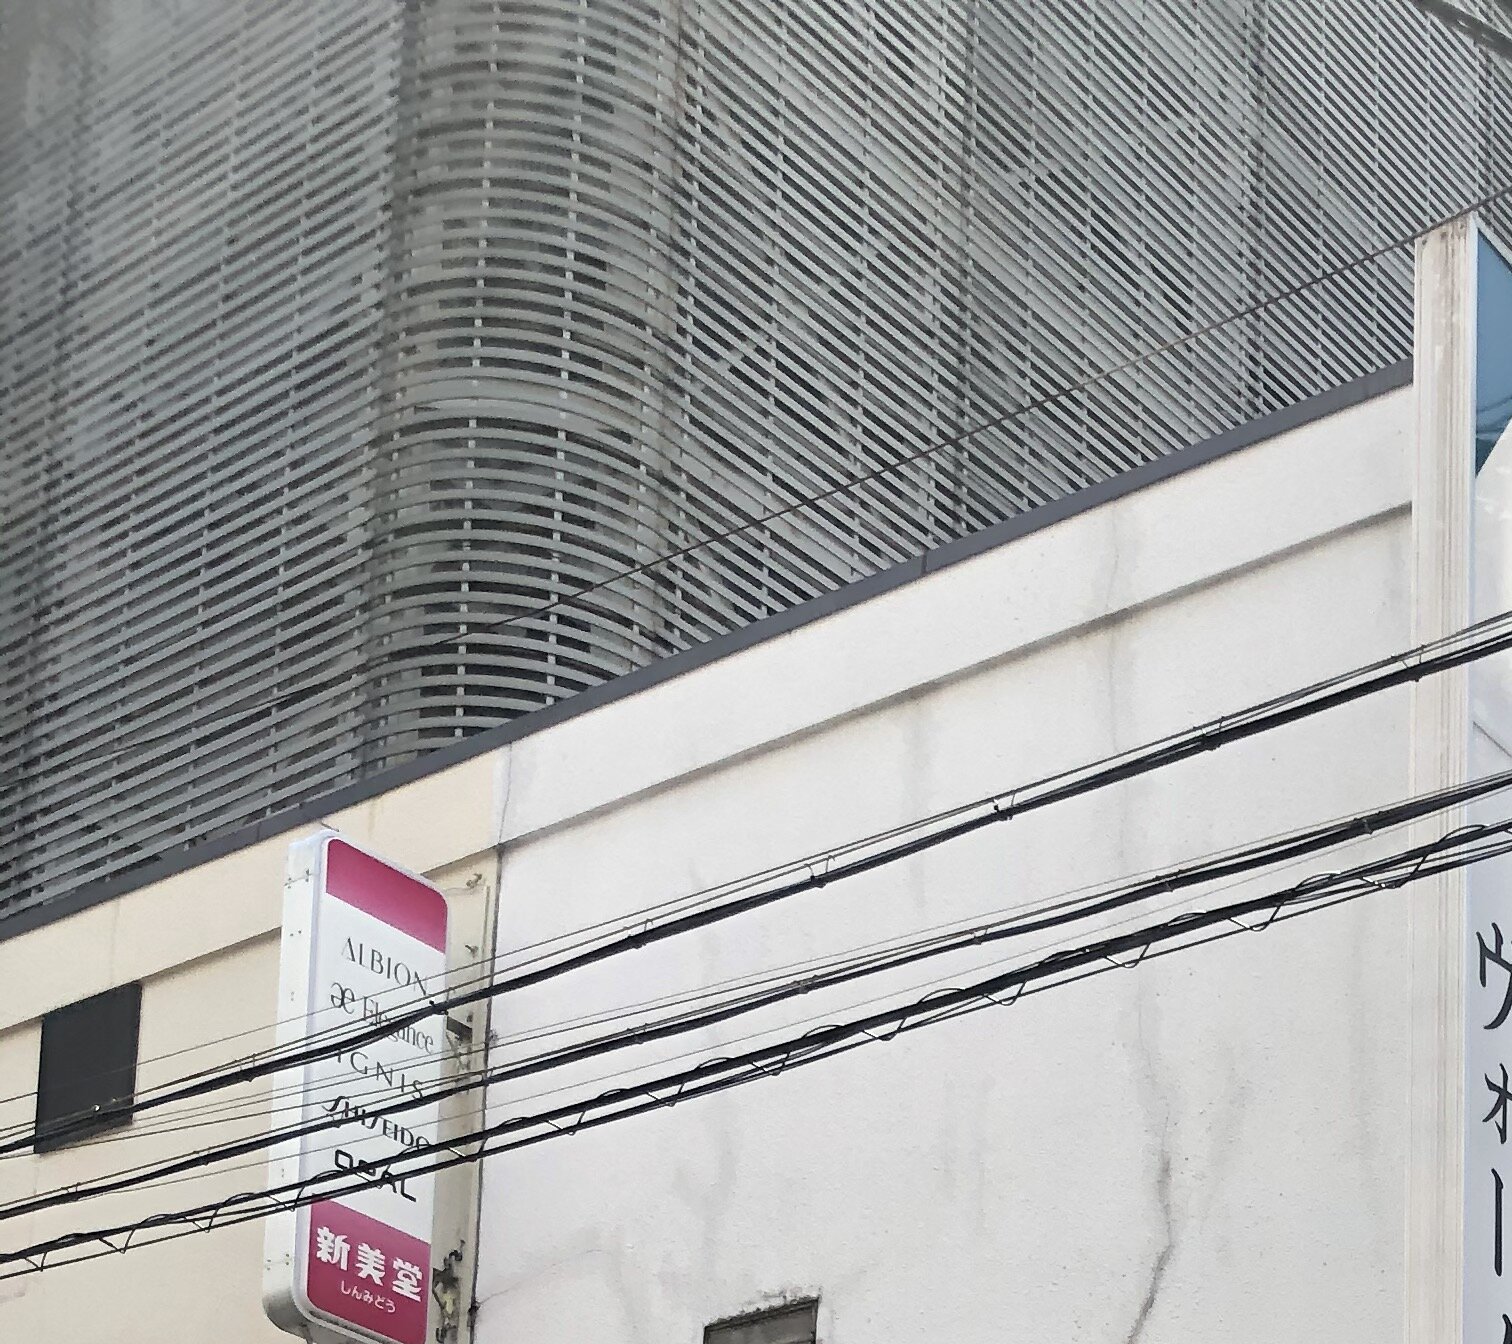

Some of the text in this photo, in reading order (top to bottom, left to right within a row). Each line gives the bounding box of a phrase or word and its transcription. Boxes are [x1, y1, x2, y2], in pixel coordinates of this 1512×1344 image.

[342, 937, 428, 996] ALBION
[362, 996, 434, 1054] Eleance
[316, 1225, 423, 1302] 新美堂
[340, 1281, 396, 1313] しんみどう
